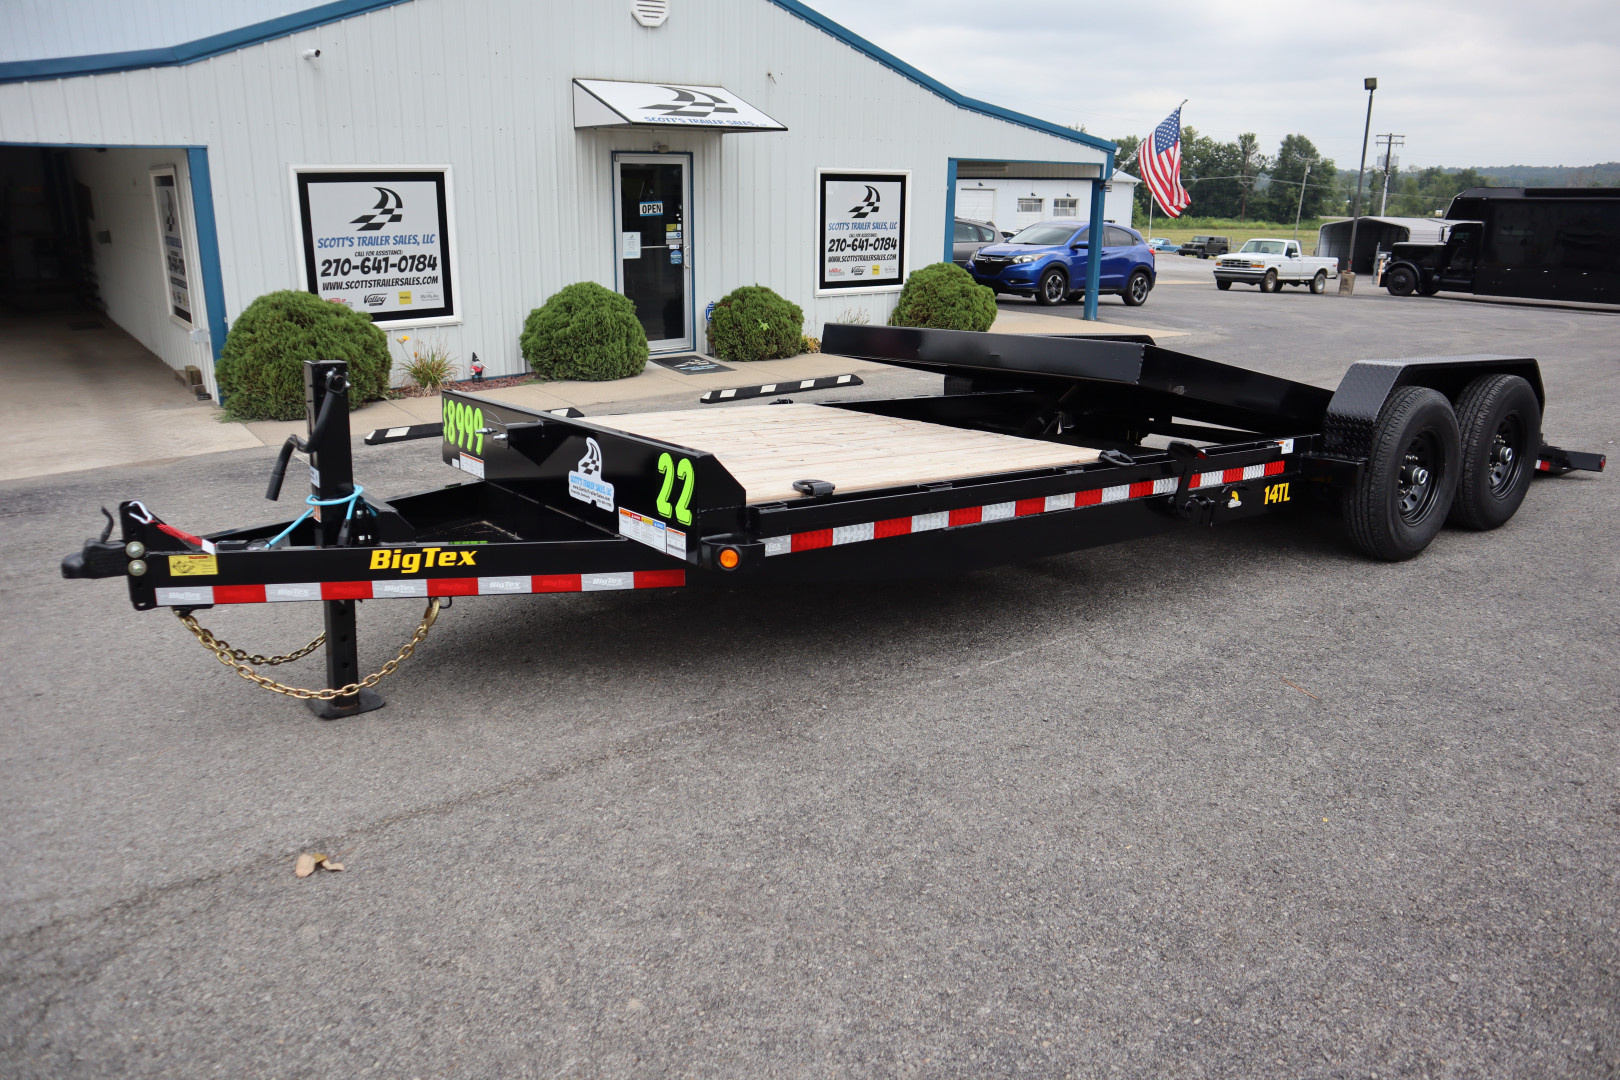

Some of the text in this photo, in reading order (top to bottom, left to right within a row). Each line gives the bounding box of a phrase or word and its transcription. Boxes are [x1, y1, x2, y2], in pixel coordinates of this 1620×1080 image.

[642, 204, 661, 214] OPEN
[828, 221, 898, 231] SCOTT'S TRAILER SALES, LLC
[317, 234, 436, 248] SCOTT'S TRAILER SALES, LLC
[828, 237, 897, 252] 270-641-0784
[320, 254, 438, 277] 270-641-0784
[828, 254, 897, 263] WWW.SCOTTSTRAILERSALES.COM
[322, 276, 438, 291] WWW.SCOTTSTRAILERSALES.COM
[363, 294, 387, 304] Valley
[443, 397, 484, 456] $8999
[656, 452, 695, 527] 22
[1264, 482, 1290, 505] 14TL
[369, 547, 478, 574] BigTex
[592, 577, 623, 585] BigTex
[383, 584, 416, 593] BigTex
